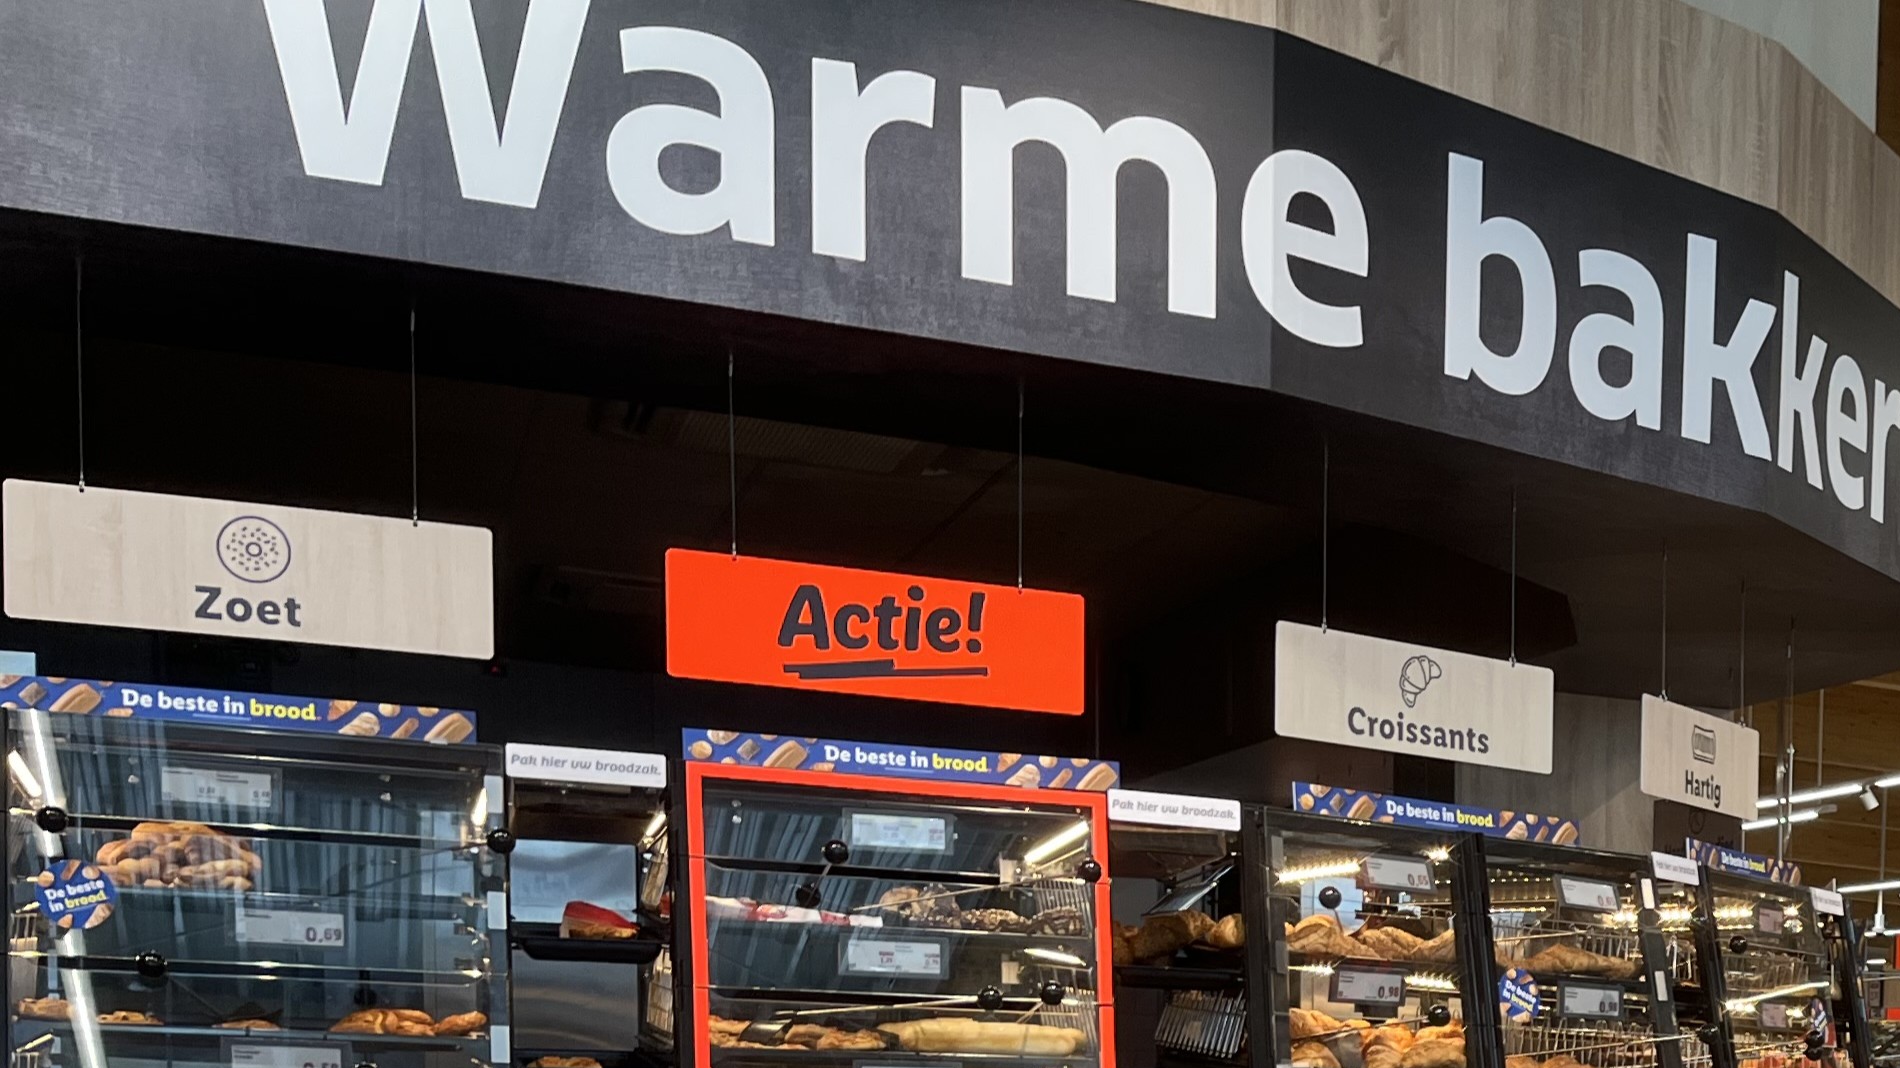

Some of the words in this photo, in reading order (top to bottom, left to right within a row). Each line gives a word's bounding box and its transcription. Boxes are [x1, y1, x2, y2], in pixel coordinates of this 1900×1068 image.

[258, 0, 1371, 349] Warme
[195, 585, 302, 628] Zoet
[777, 583, 987, 654] Actie!
[121, 688, 153, 709] De
[157, 691, 218, 713] beste
[223, 696, 245, 715] in
[1348, 706, 1489, 754] Croissants
[511, 753, 537, 766] Pak
[541, 756, 568, 769] hier
[571, 760, 592, 770] uw
[824, 745, 850, 762] De
[855, 747, 906, 767] beste
[910, 750, 928, 768] in
[1685, 769, 1721, 809] Hartig
[1112, 799, 1134, 809] Pak
[1137, 801, 1159, 812] hier
[1161, 805, 1179, 814] uw
[1386, 800, 1404, 816] De
[1406, 802, 1440, 821] beste
[1442, 807, 1455, 823] in
[44, 888, 66, 900] De
